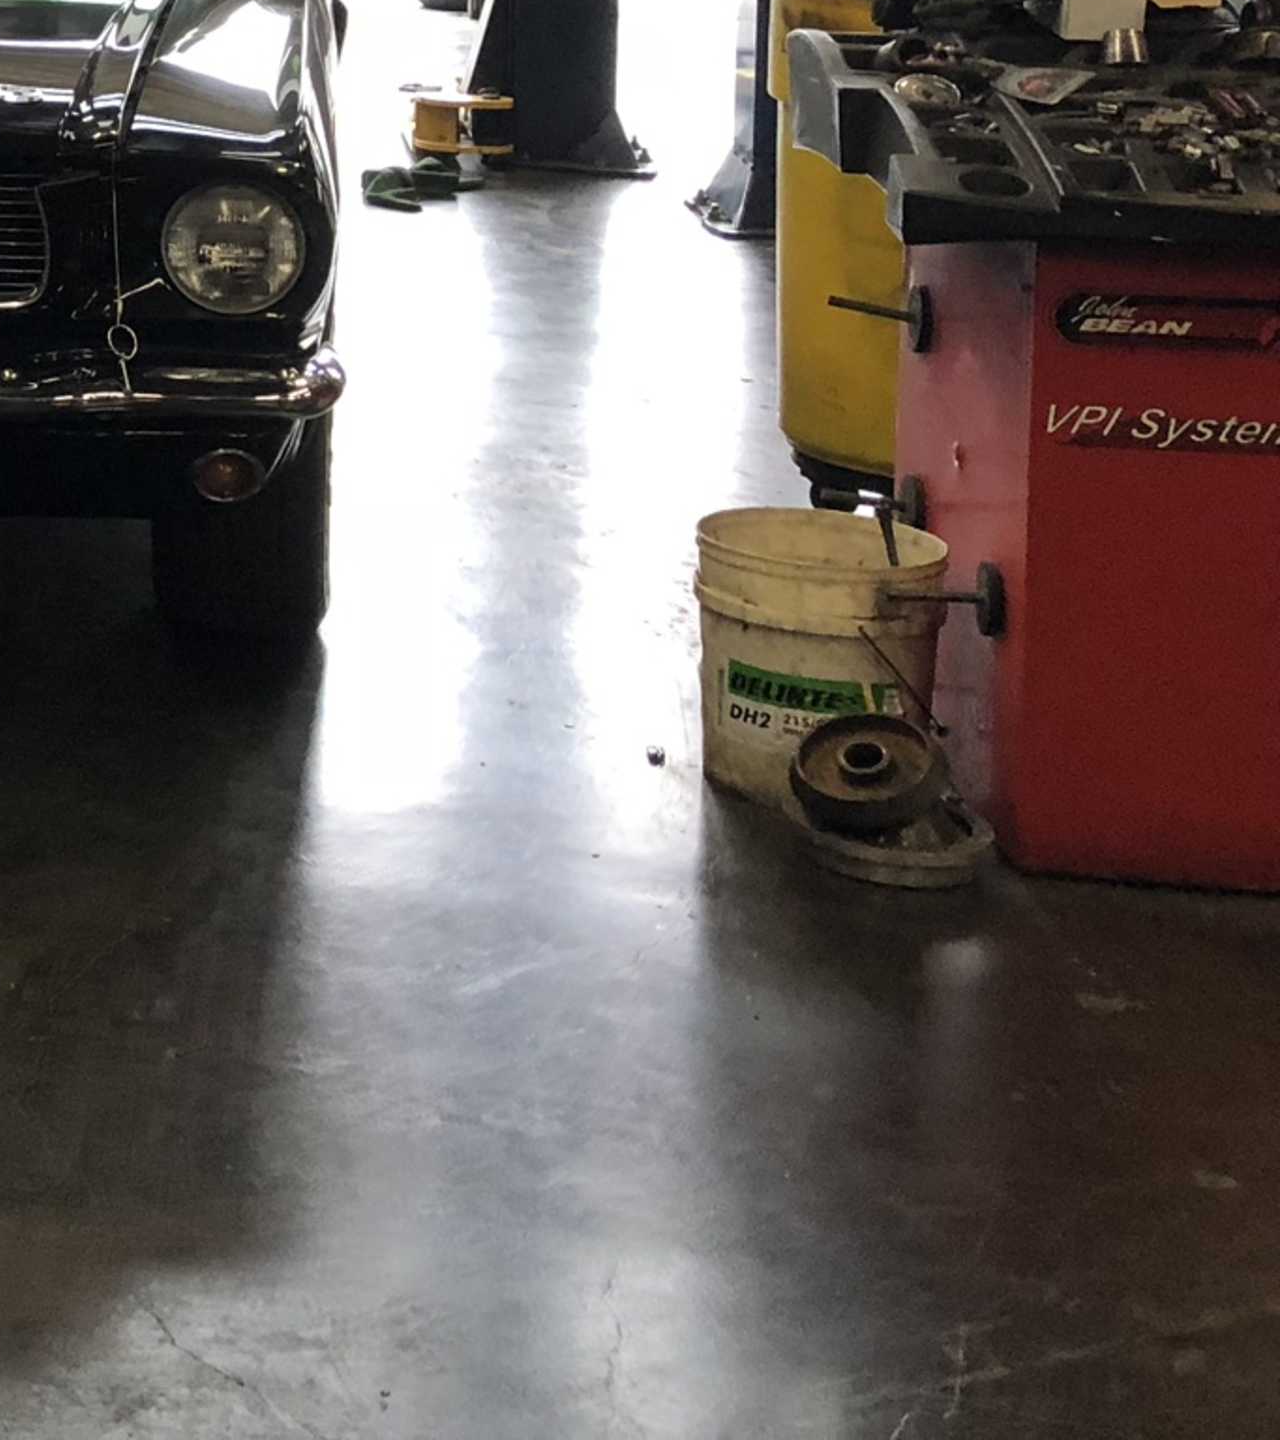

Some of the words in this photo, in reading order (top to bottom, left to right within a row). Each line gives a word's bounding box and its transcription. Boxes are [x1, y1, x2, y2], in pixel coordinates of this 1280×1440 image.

[1079, 317, 1193, 335] BEAN
[1046, 403, 1124, 437] VPI
[729, 703, 772, 729] DH2
